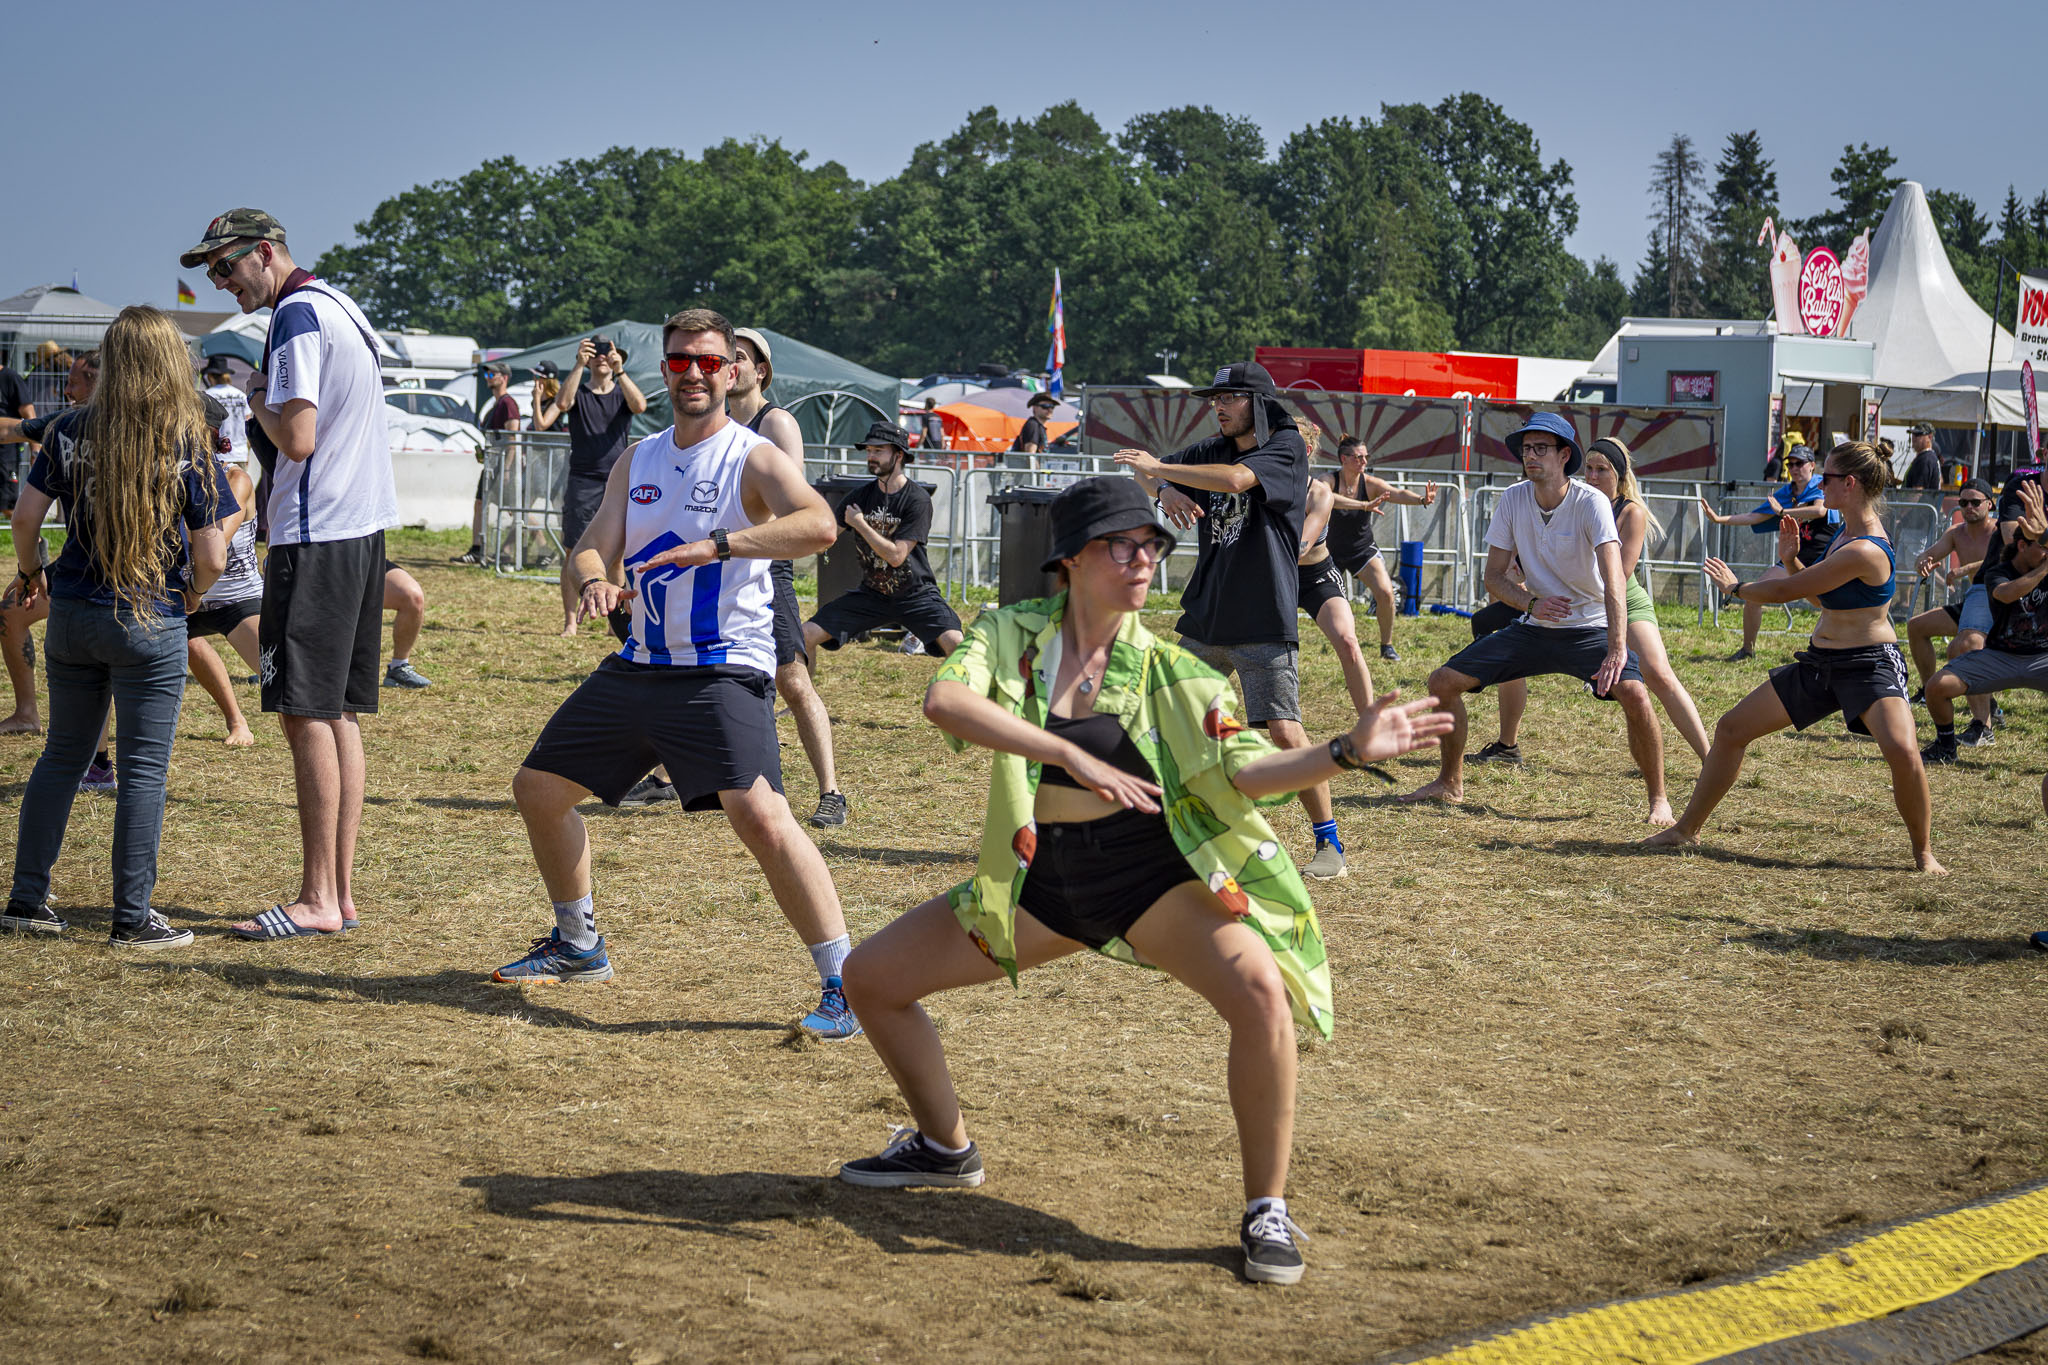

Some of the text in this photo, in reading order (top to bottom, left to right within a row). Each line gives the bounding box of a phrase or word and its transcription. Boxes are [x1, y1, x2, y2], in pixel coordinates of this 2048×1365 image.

[1804, 286, 1834, 326] Baby
[2036, 349, 2048, 361] St
[279, 350, 289, 389] VIACTIV
[632, 488, 659, 500] AFL
[684, 504, 718, 514] mazda
